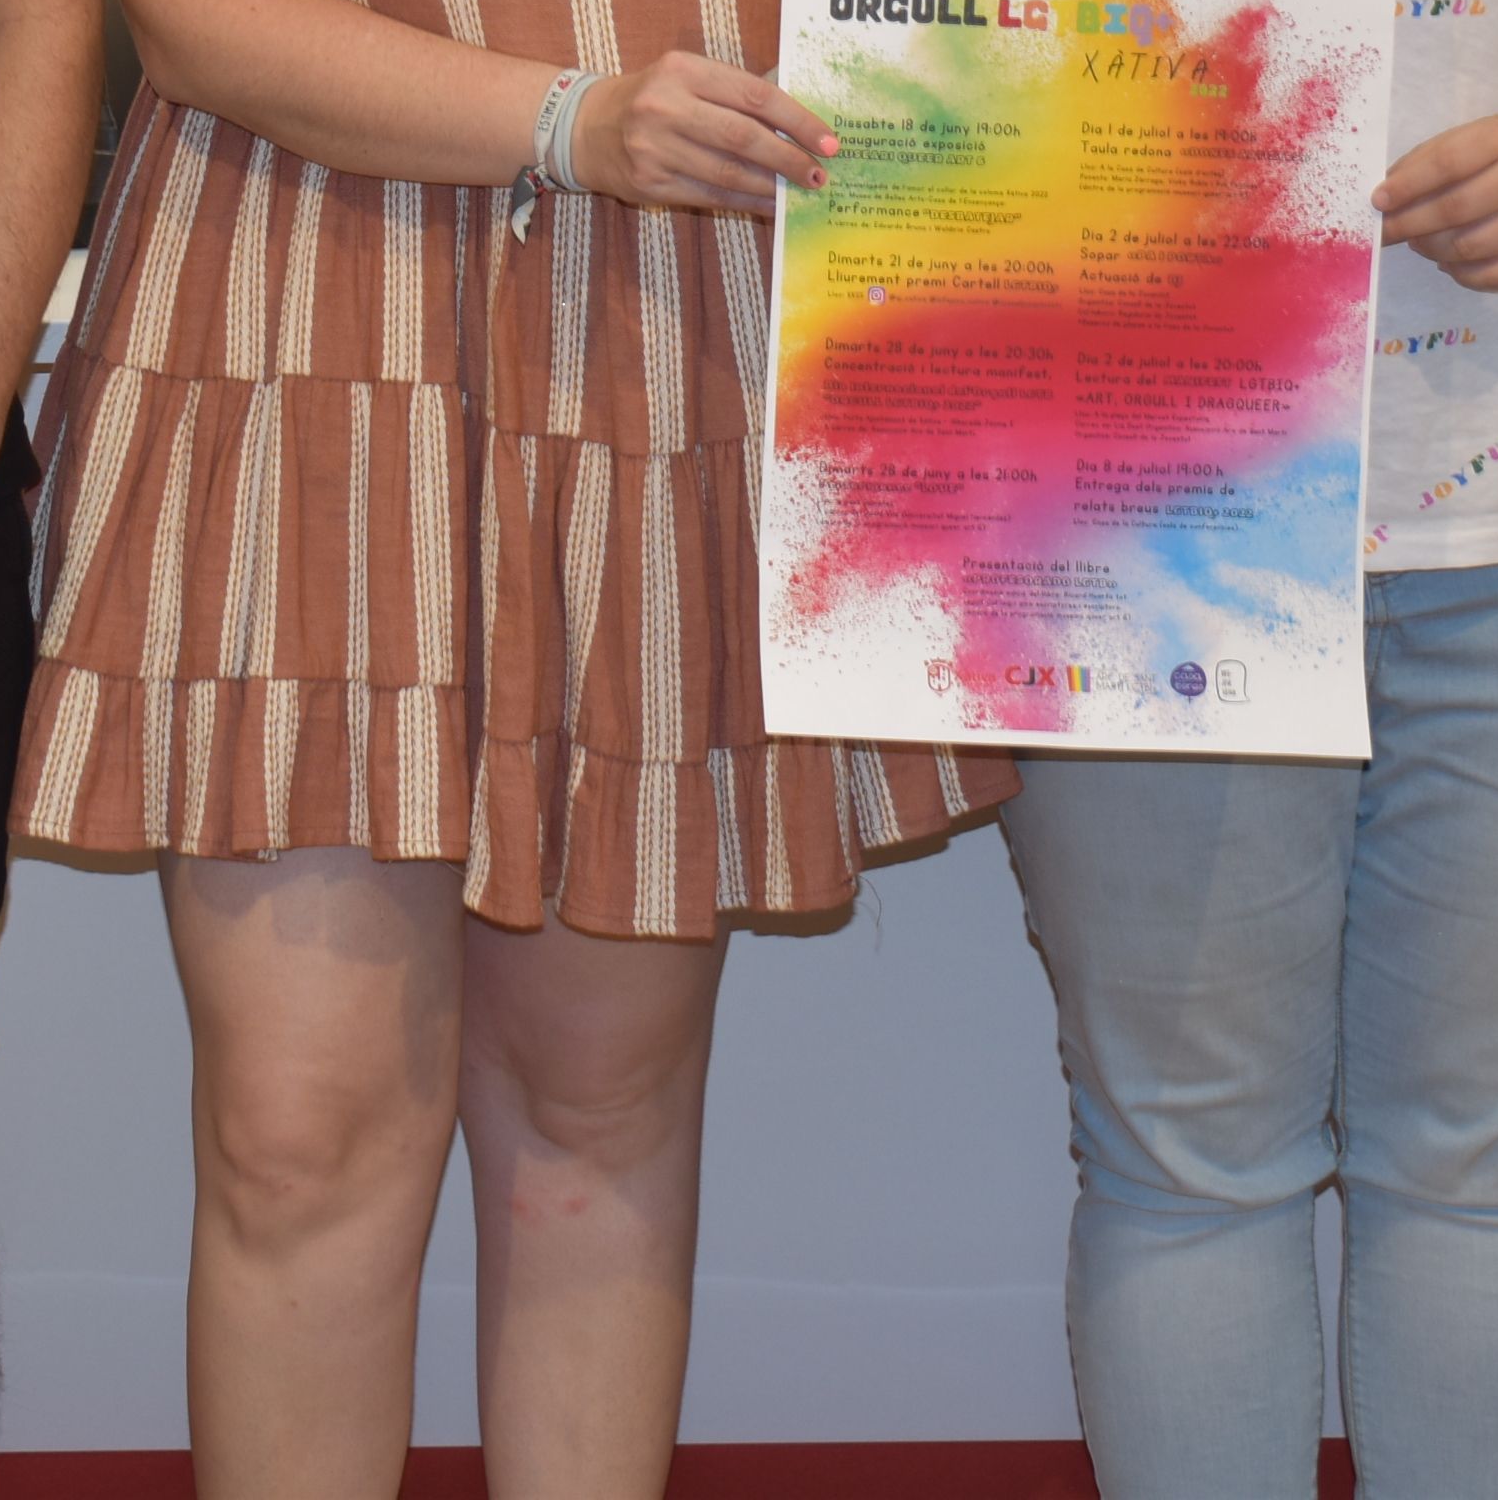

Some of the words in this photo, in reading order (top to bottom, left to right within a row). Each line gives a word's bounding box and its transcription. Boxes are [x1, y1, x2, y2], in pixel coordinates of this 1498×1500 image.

[1082, 50, 1209, 83] XÀTIVA
[834, 115, 895, 131] Dissabte
[901, 119, 913, 132] 18
[919, 120, 936, 133] de
[941, 122, 970, 136] juny
[976, 122, 1021, 137] 19:00h
[1082, 121, 1102, 135] Dia
[1118, 124, 1133, 137] de
[1138, 125, 1170, 140] juliol
[1176, 130, 1184, 139] a
[1190, 128, 1209, 141] les
[923, 138, 986, 152] exposició
[1081, 140, 1118, 155] Taula
[1123, 144, 1172, 157] redona
[829, 200, 920, 217] Performance
[1082, 227, 1103, 242] Dia
[1109, 229, 1117, 242] 2
[1123, 230, 1139, 243] de
[1144, 232, 1178, 246] juliol
[1183, 237, 1191, 246] a
[1198, 234, 1217, 247] les
[828, 251, 883, 267] Dimarts
[889, 253, 901, 267] 21
[907, 255, 923, 268] de
[928, 257, 957, 272] juny
[965, 261, 972, 270] a
[979, 258, 997, 272] les
[1004, 259, 1054, 274] 20:00h
[1080, 247, 1120, 262] Sopar
[827, 269, 900, 284] Lliurement
[907, 275, 946, 288] premi
[952, 276, 1000, 290] Cartell
[1080, 269, 1140, 284] Actuació
[1146, 272, 1162, 285] de
[825, 337, 879, 353] Dimarts
[886, 341, 901, 354] 28
[908, 342, 924, 356] de
[930, 345, 959, 359] juny
[965, 349, 973, 357] a
[979, 345, 998, 359] les
[824, 356, 915, 373] Concentració
[930, 362, 980, 376] lectura
[1078, 352, 1098, 366] Dia
[1104, 353, 1112, 366] 2
[1118, 355, 1133, 367] de
[1139, 356, 1170, 370] juliol
[1076, 372, 1131, 386] Lectura
[1136, 374, 1157, 387] del
[1124, 394, 1178, 408] ORGULL
[902, 465, 918, 478] de
[923, 467, 951, 482] juny
[957, 470, 965, 480] a
[970, 466, 989, 480] les
[1076, 458, 1097, 473] Dia
[1103, 459, 1112, 473] 8
[1117, 460, 1133, 474] de
[1138, 462, 1171, 476] juliol
[1075, 477, 1130, 493] Entrega
[1136, 481, 1162, 493] dels
[1168, 484, 1214, 496] premis
[1219, 484, 1235, 496] de
[1074, 500, 1115, 513] relats
[1121, 501, 1159, 514] breus
[963, 556, 1044, 571] Presentació
[1050, 560, 1070, 572] del
[1075, 560, 1110, 574] llibre
[1004, 666, 1056, 687] CJX
